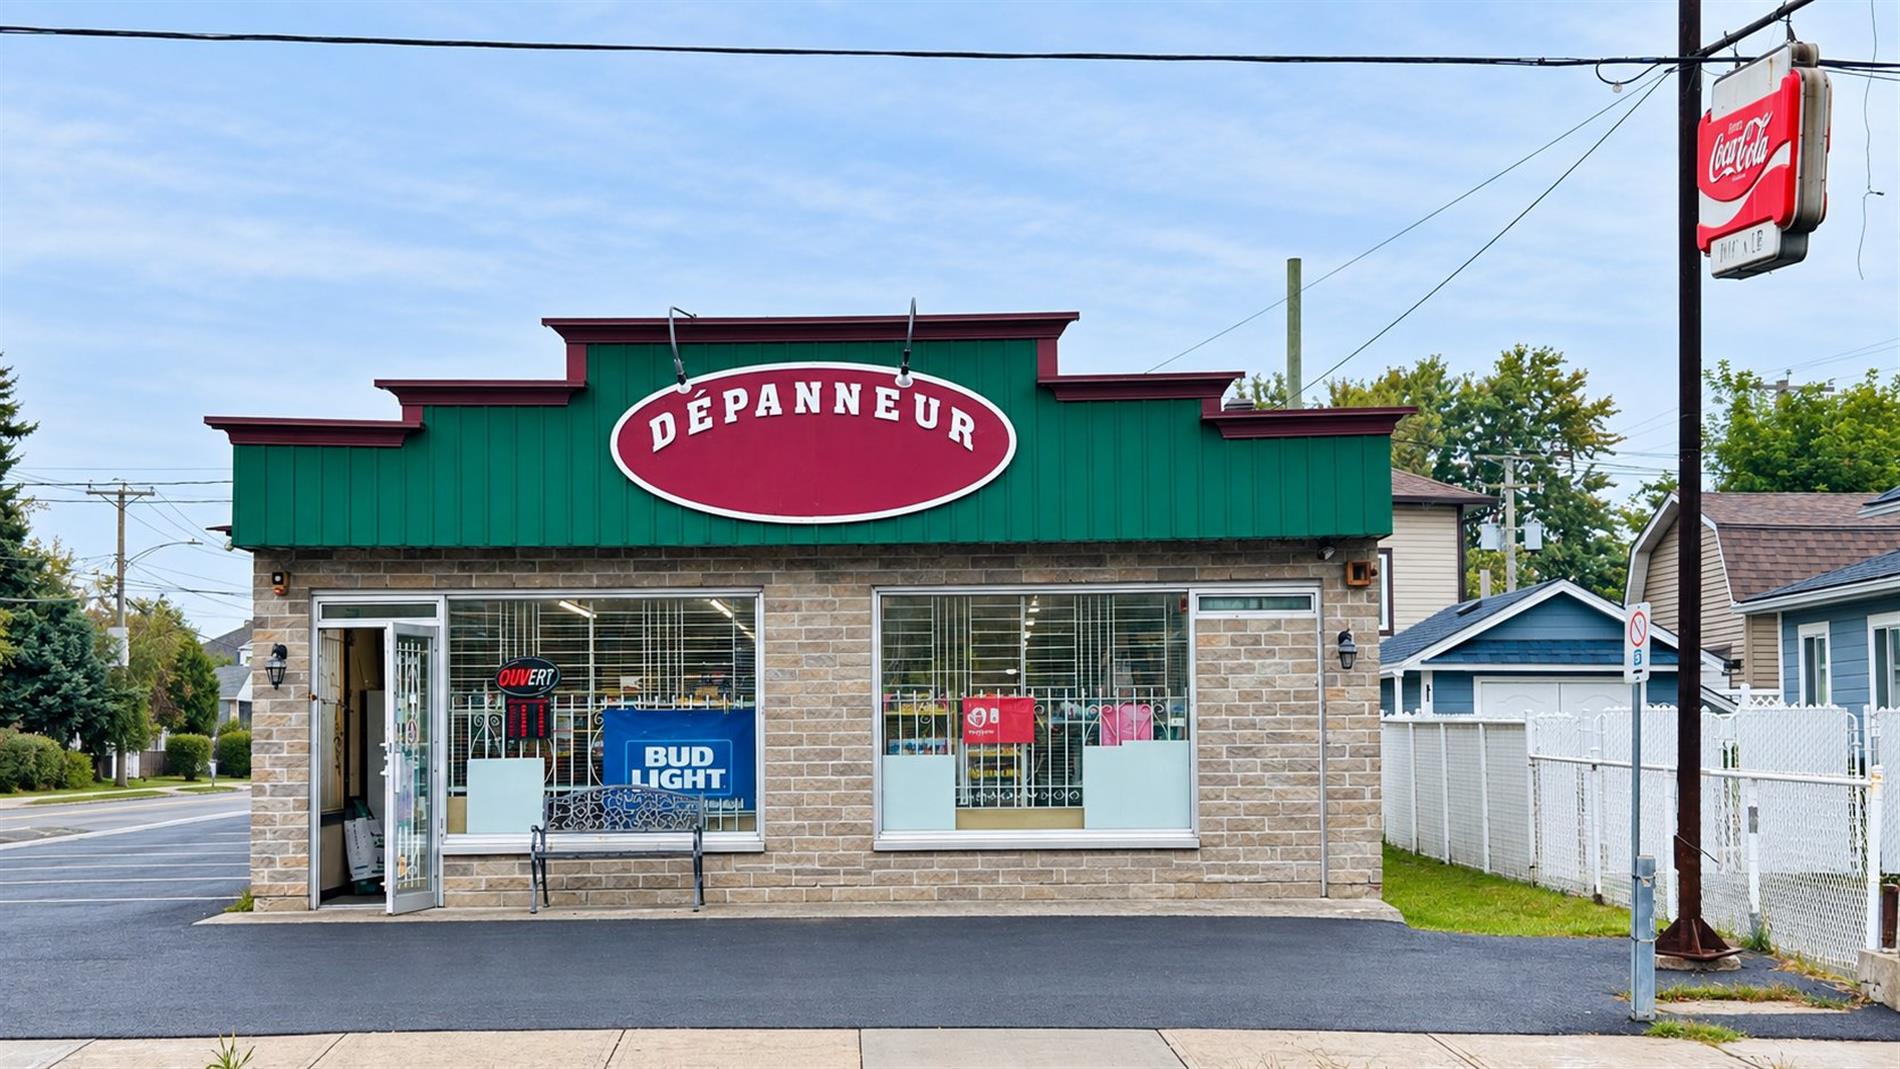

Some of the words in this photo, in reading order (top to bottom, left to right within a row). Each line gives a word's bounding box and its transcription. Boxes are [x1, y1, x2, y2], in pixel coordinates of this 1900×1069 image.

[1709, 111, 1773, 183] Coca-Cola
[649, 381, 974, 453] DÉPANNEUR
[498, 668, 555, 687] OUVERT
[645, 746, 714, 767] BUD
[632, 768, 726, 792] LIGHT
